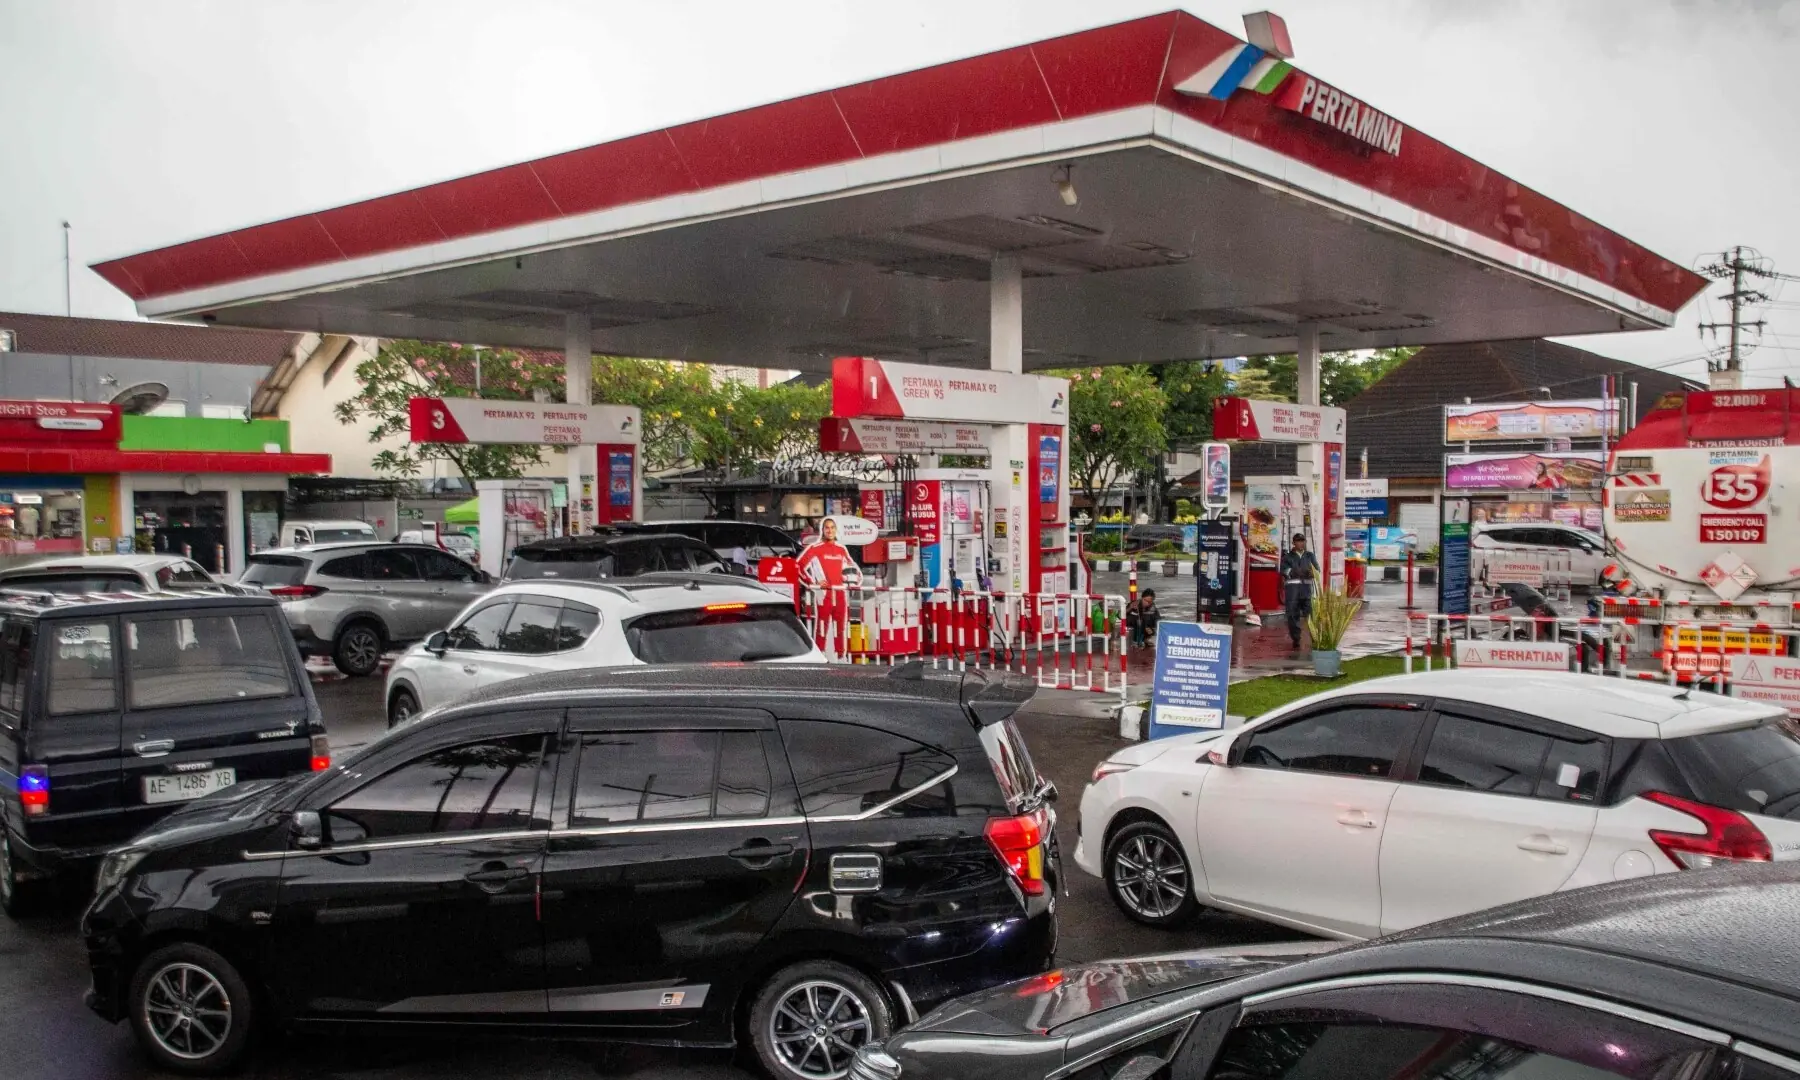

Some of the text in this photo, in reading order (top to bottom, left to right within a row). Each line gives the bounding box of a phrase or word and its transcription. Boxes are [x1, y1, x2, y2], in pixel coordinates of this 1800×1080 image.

[1297, 78, 1404, 157] PERTAMINA
[869, 376, 878, 400] 1
[902, 376, 944, 389] PERTAMAX
[949, 380, 997, 393] PERTAMAX 92
[903, 387, 944, 399] GREEN 95
[36, 404, 67, 416] Store
[483, 410, 536, 420] PERTAMAX 92
[543, 411, 588, 421] PERTALITE 90
[431, 410, 445, 429] 3
[1241, 409, 1249, 427] 5
[543, 425, 582, 434] PERTAMAX
[840, 427, 849, 442] 7
[543, 434, 582, 443] GREEN 95
[1738, 437, 1786, 448] LOGISTIK
[1709, 450, 1759, 458] PERTAMINA
[1703, 473, 1758, 502] 135
[1702, 518, 1765, 527] EMERGENCY CALL
[1707, 530, 1760, 541] 150109
[1504, 563, 1541, 571] PERHATIAN
[1168, 635, 1221, 649] PELANGGAN
[1167, 646, 1221, 659] TERHORMAT
[1488, 649, 1564, 663] PERHATIAN
[1741, 690, 1779, 700] DILARANG
[177, 763, 207, 771] TOYOTA
[150, 771, 231, 794] AE 1486 XB
